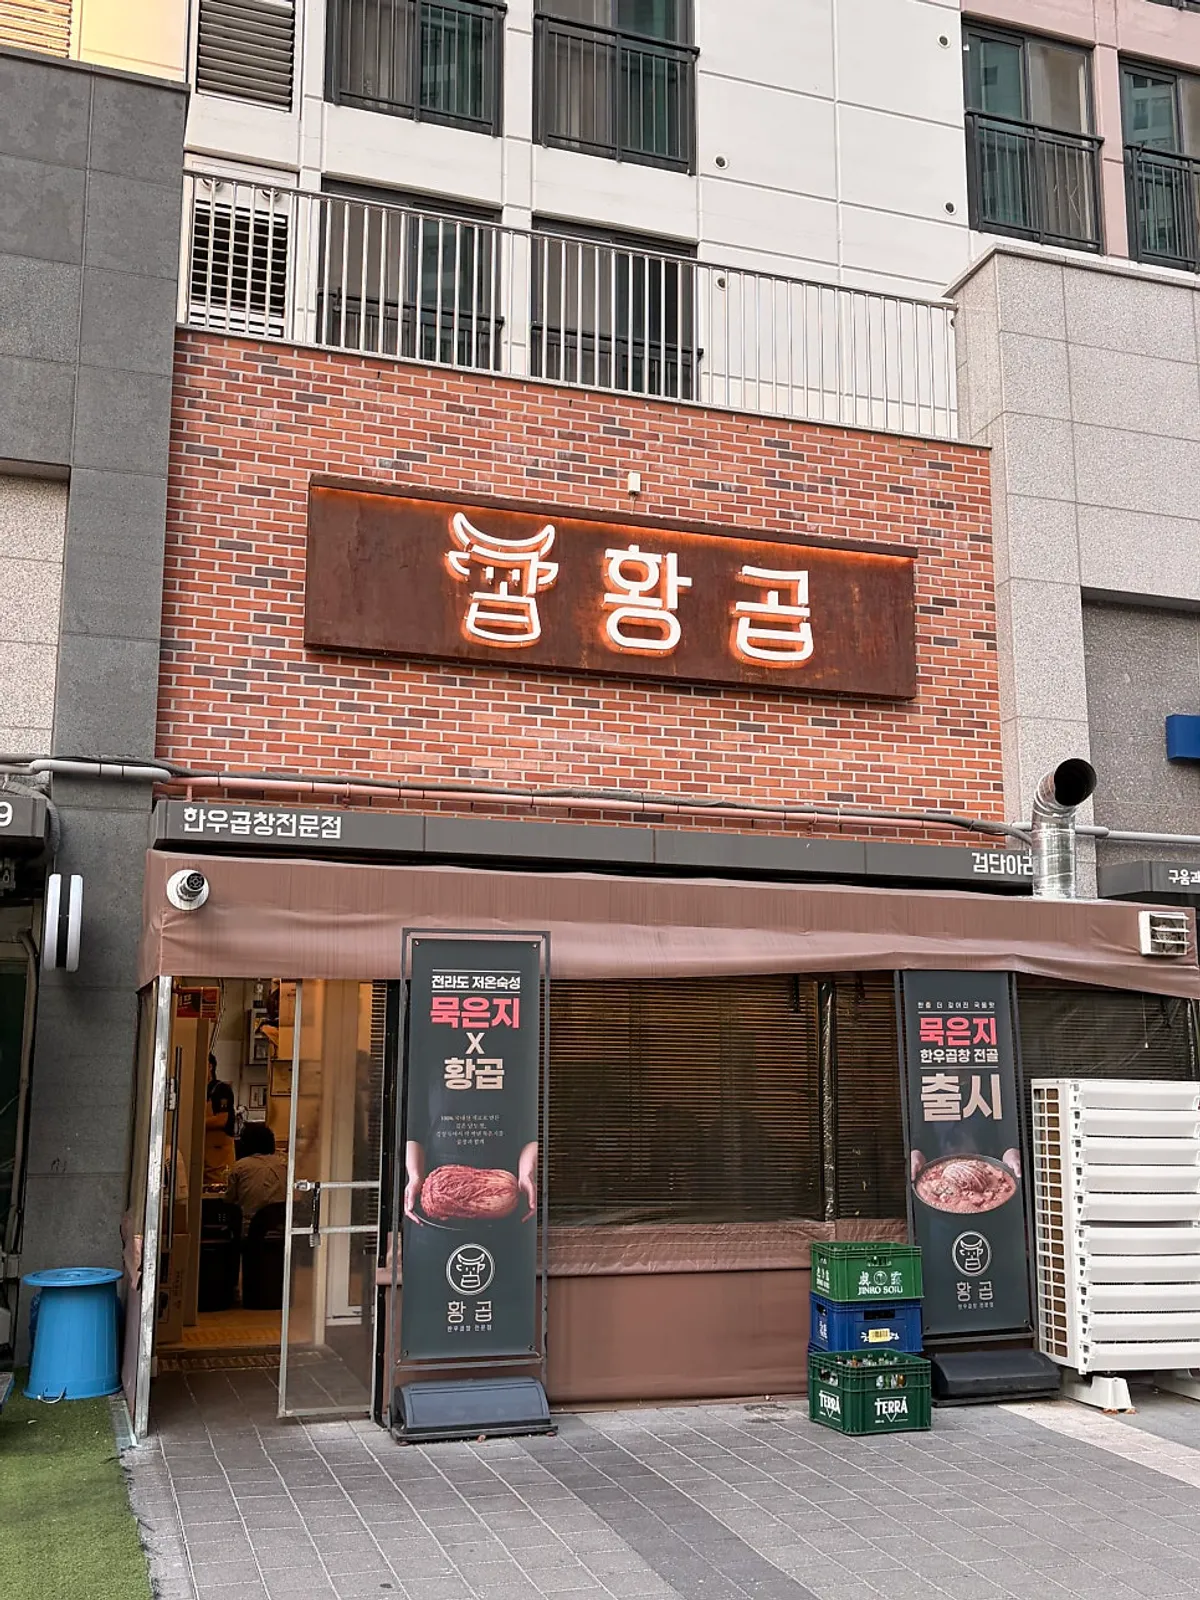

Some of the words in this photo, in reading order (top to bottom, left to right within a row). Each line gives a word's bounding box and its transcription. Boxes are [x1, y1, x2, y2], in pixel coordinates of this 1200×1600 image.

[183, 806, 342, 839] 한우곱창전문점
[431, 975, 469, 990] 전라도
[471, 976, 521, 990] 저온숙성
[430, 996, 520, 1029] 묵은지
[465, 1032, 486, 1055] X
[919, 1017, 997, 1046] 묵은지
[920, 1048, 971, 1063] 한우곱창
[973, 1048, 999, 1063] 전골
[443, 1057, 505, 1090] 황곱
[920, 1073, 1003, 1122] 출시
[818, 1391, 841, 1414] TERRA
[874, 1398, 908, 1416] TERRA
